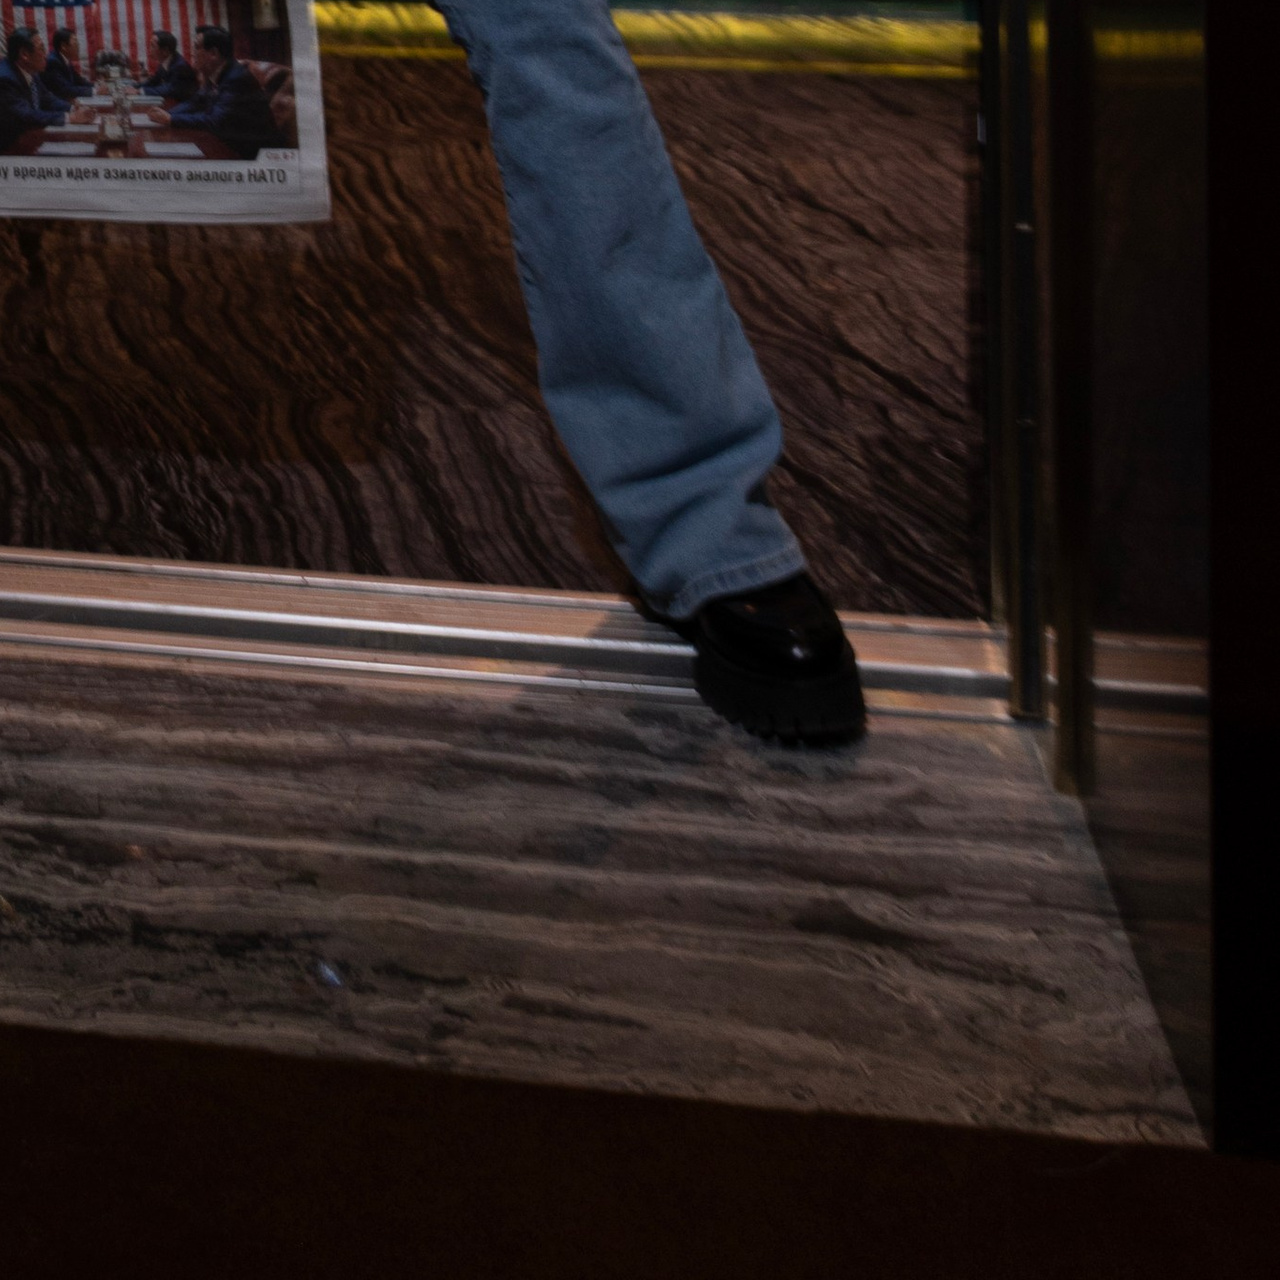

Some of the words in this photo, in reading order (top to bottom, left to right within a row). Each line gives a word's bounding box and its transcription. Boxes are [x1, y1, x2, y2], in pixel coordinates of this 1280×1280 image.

[13, 166, 62, 180] вредна
[66, 167, 99, 181] идея
[103, 167, 182, 182] азиатского
[186, 169, 244, 182] аналога
[247, 167, 287, 184] НАТО
